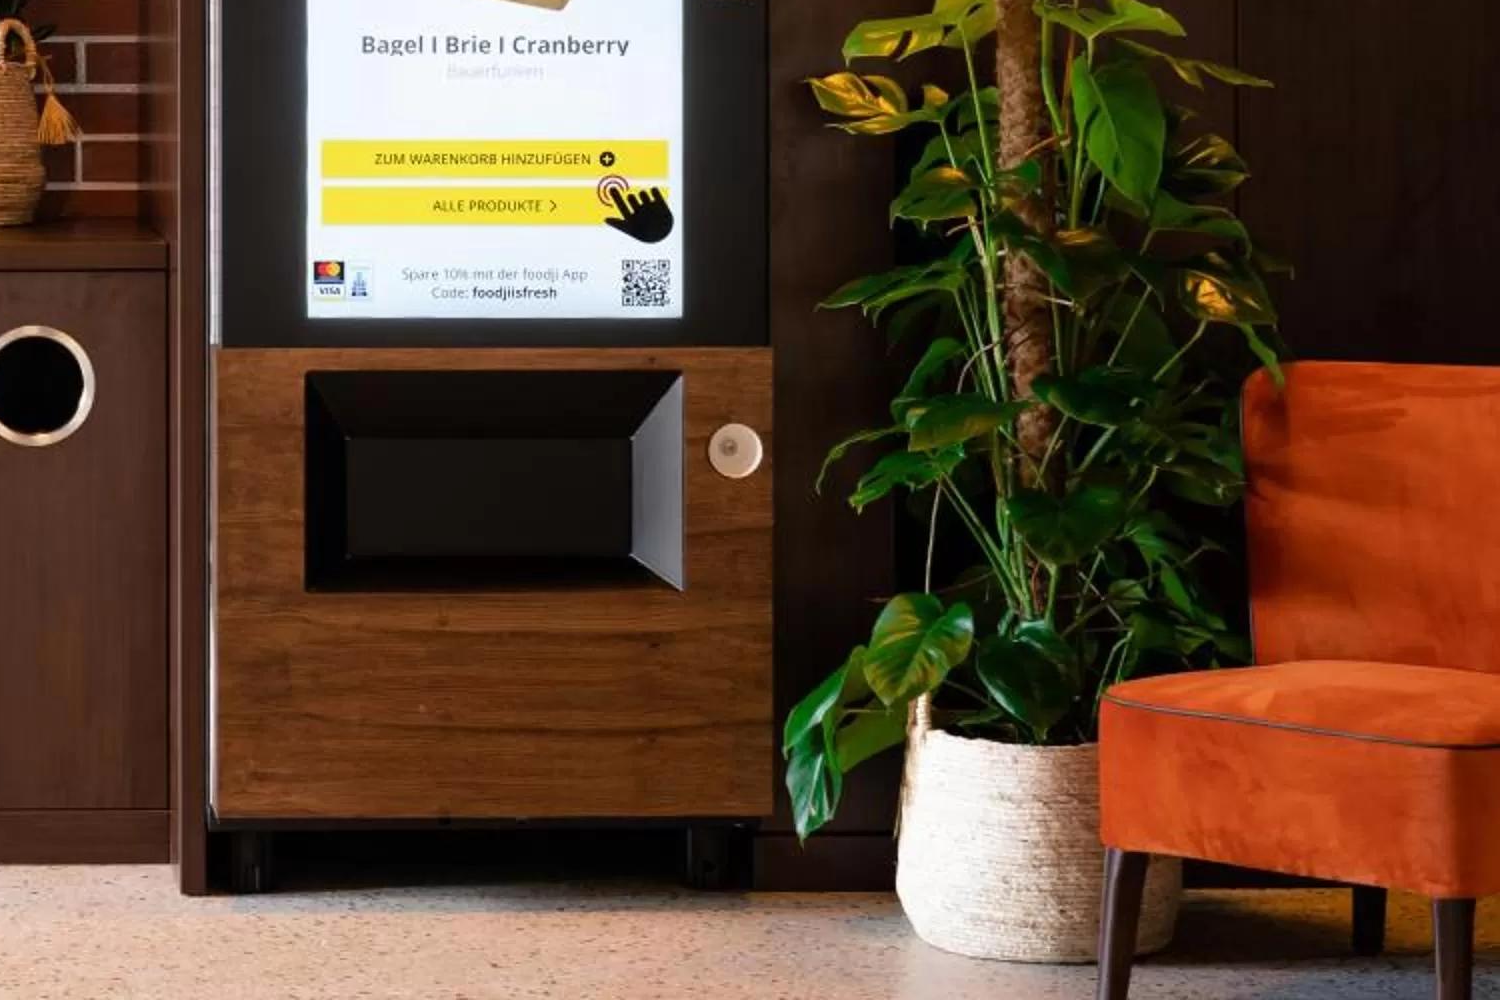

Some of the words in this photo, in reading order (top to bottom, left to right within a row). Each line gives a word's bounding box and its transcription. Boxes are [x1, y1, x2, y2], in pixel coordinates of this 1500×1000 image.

[361, 36, 423, 56] Bagel
[445, 36, 492, 54] Brie
[512, 35, 630, 56] Cranberry
[374, 153, 405, 165] ZUM
[409, 153, 497, 165] WARENKORB
[501, 150, 591, 165] HINZUFÜGEN
[433, 200, 464, 213] ALLE
[469, 200, 541, 213] PRODUKTE
[401, 268, 439, 283] Spare
[444, 268, 467, 281] 10%
[473, 268, 493, 281] mit
[498, 267, 518, 281] der
[523, 267, 559, 283] foodji
[561, 269, 589, 283] App
[431, 286, 469, 299] Code:
[472, 285, 557, 301] foodjiisfresh
